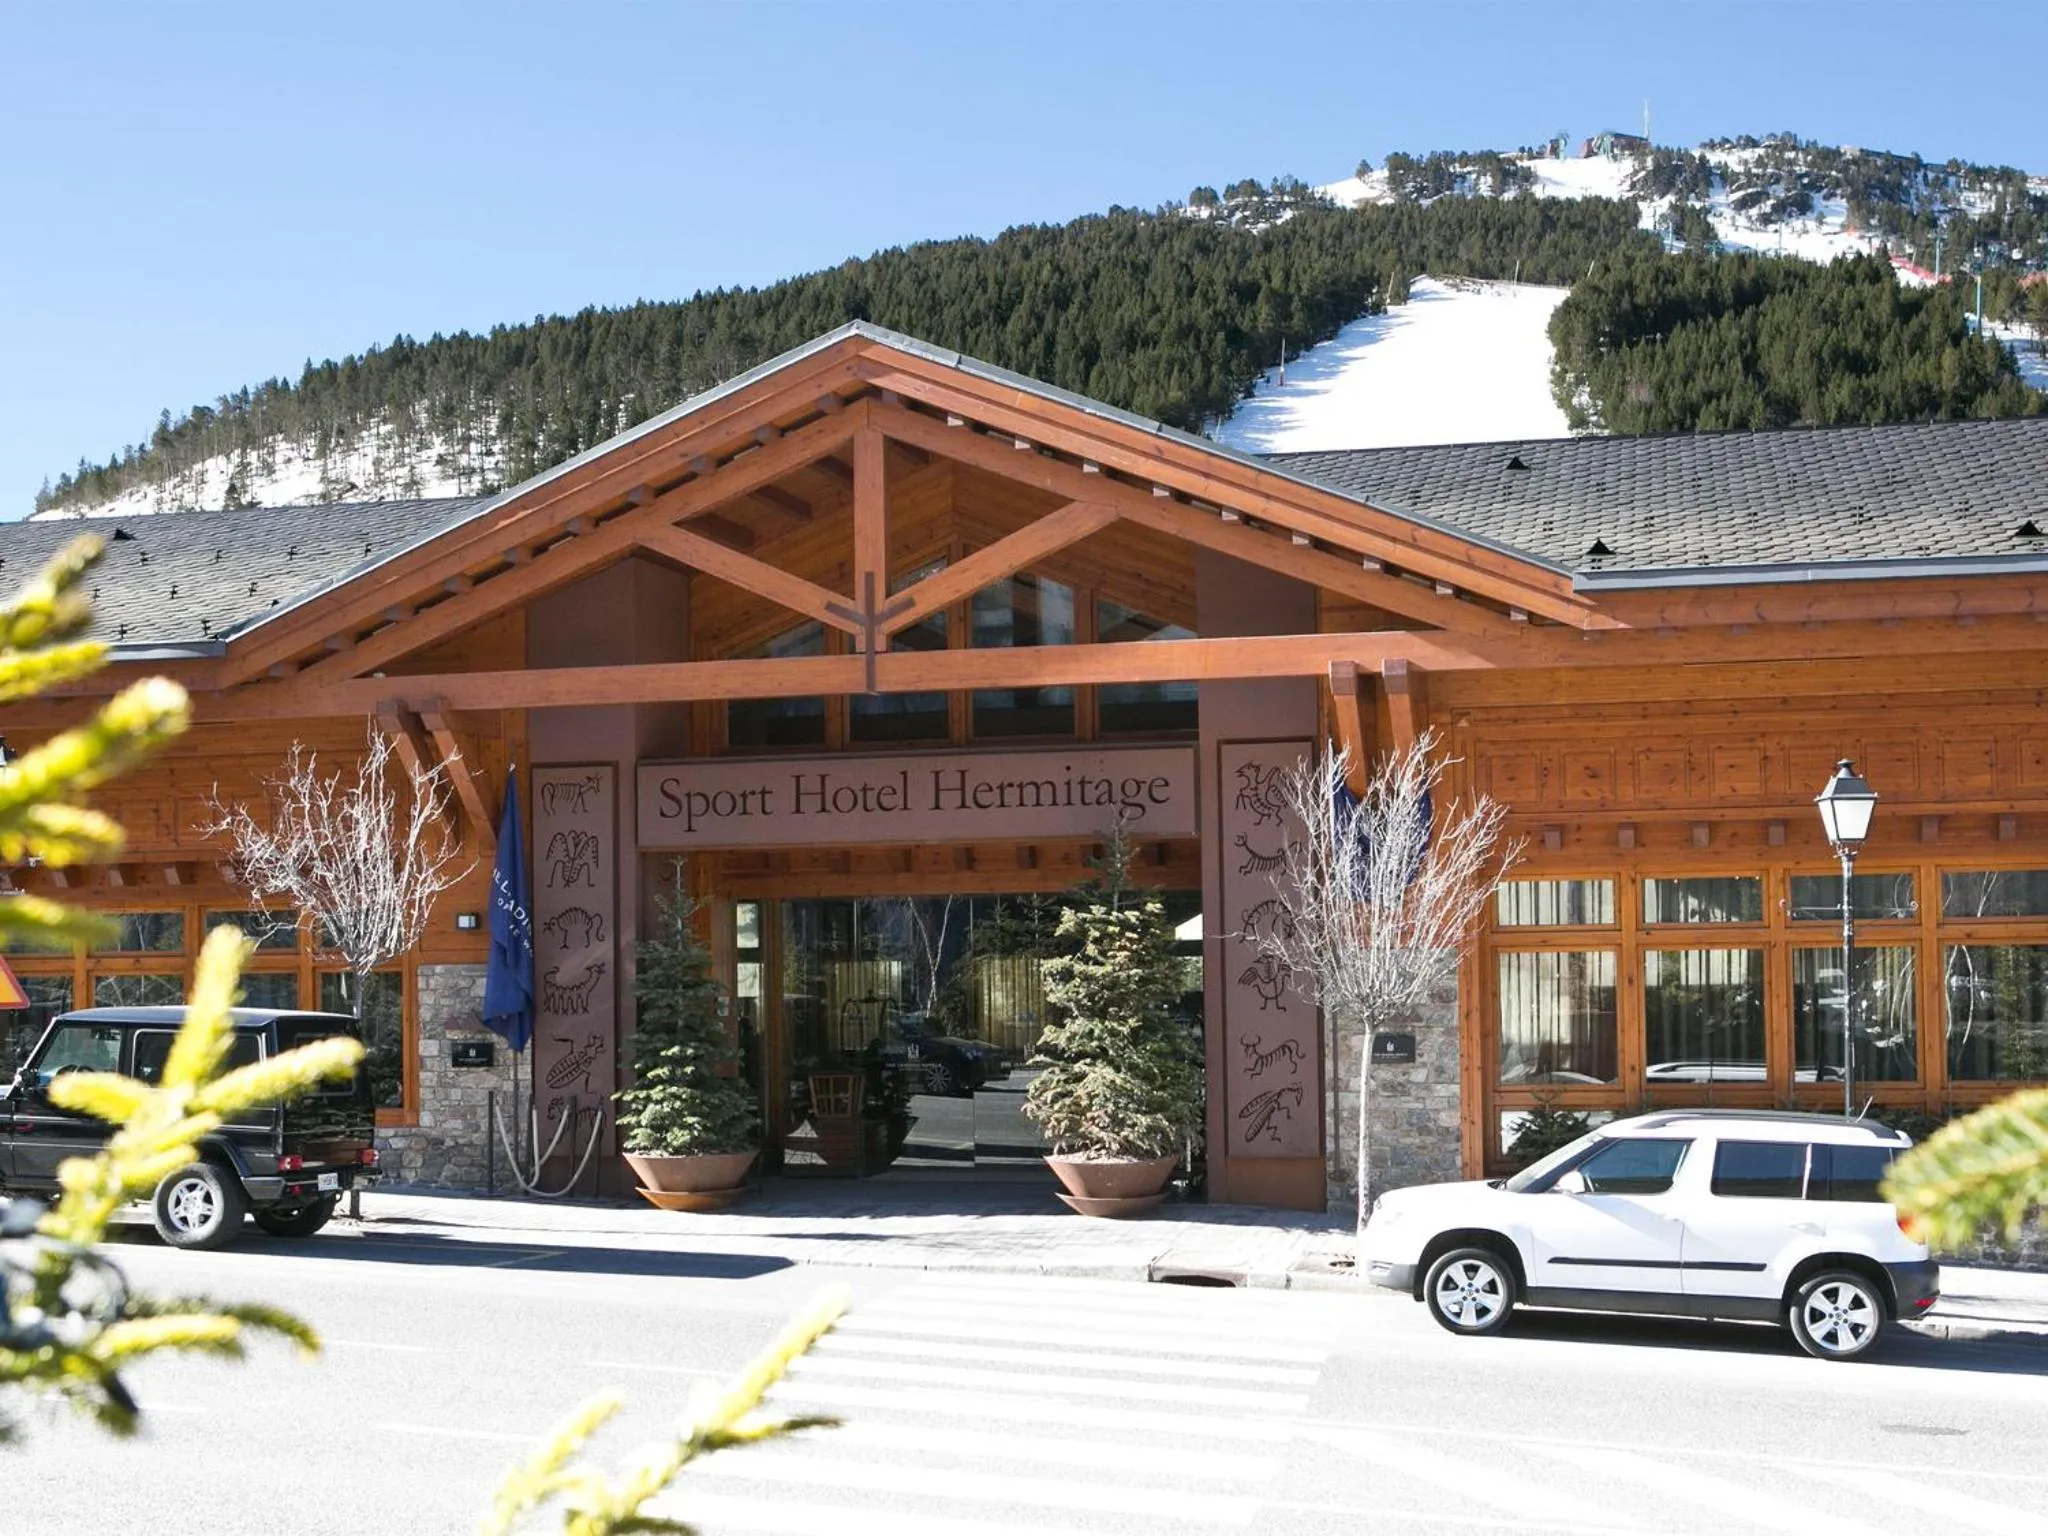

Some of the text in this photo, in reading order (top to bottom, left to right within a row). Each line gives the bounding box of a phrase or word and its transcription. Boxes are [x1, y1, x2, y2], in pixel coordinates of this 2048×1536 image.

[659, 765, 1171, 833] Sport Hotel Hermitage
